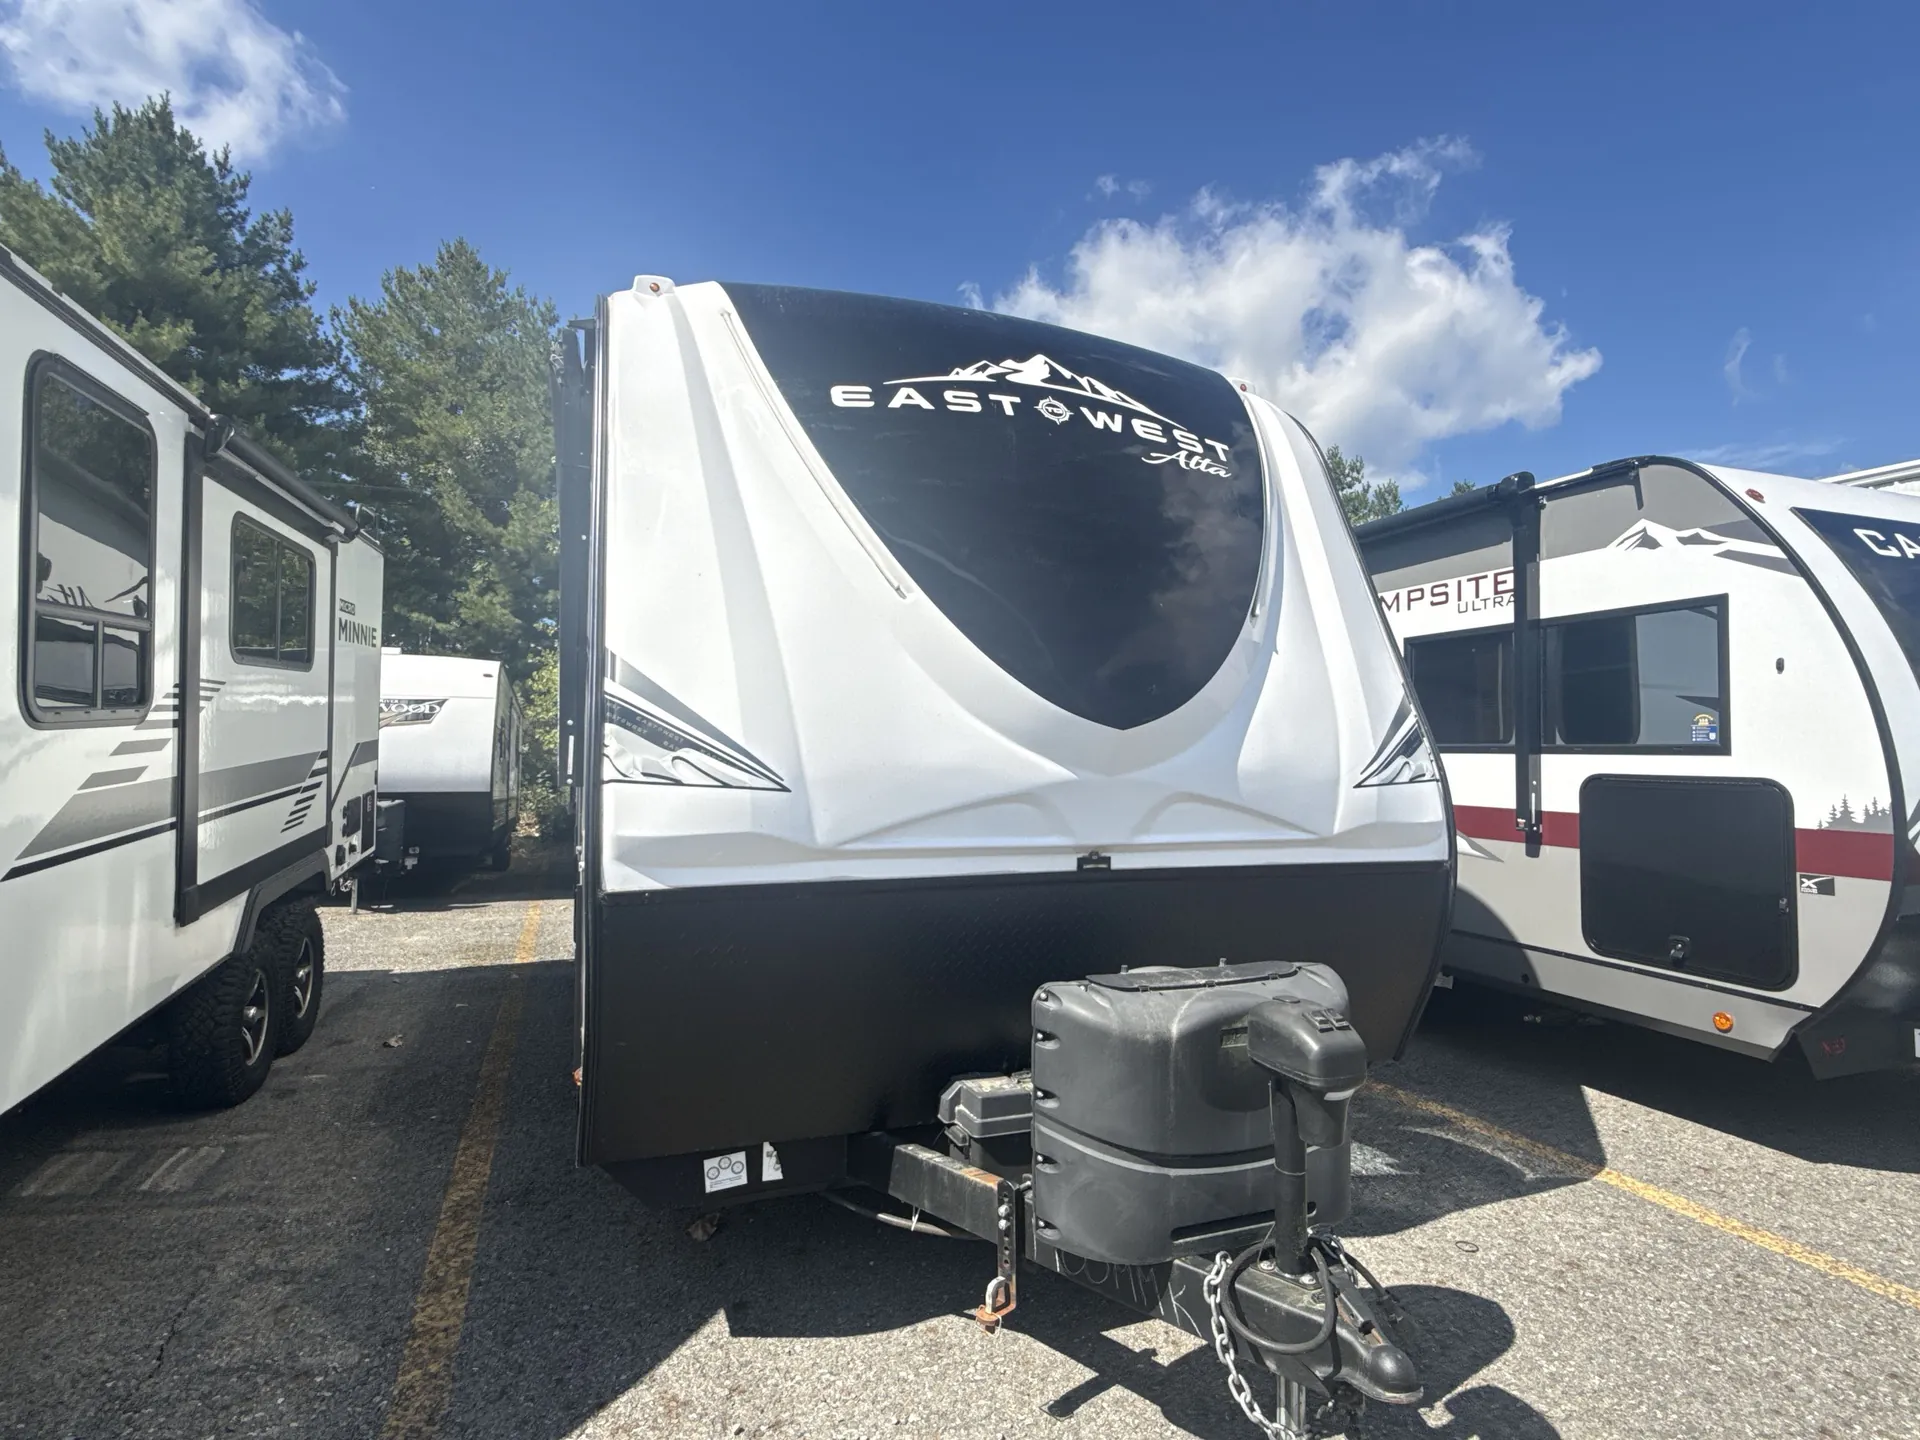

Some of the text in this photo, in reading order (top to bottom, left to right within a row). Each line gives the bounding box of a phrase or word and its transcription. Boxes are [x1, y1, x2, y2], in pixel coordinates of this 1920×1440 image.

[831, 385, 1021, 416] EAST
[1079, 406, 1230, 462] WEST
[1141, 450, 1231, 477] Alta
[1457, 593, 1515, 614] ULTRA
[338, 617, 377, 648] MINNIE
